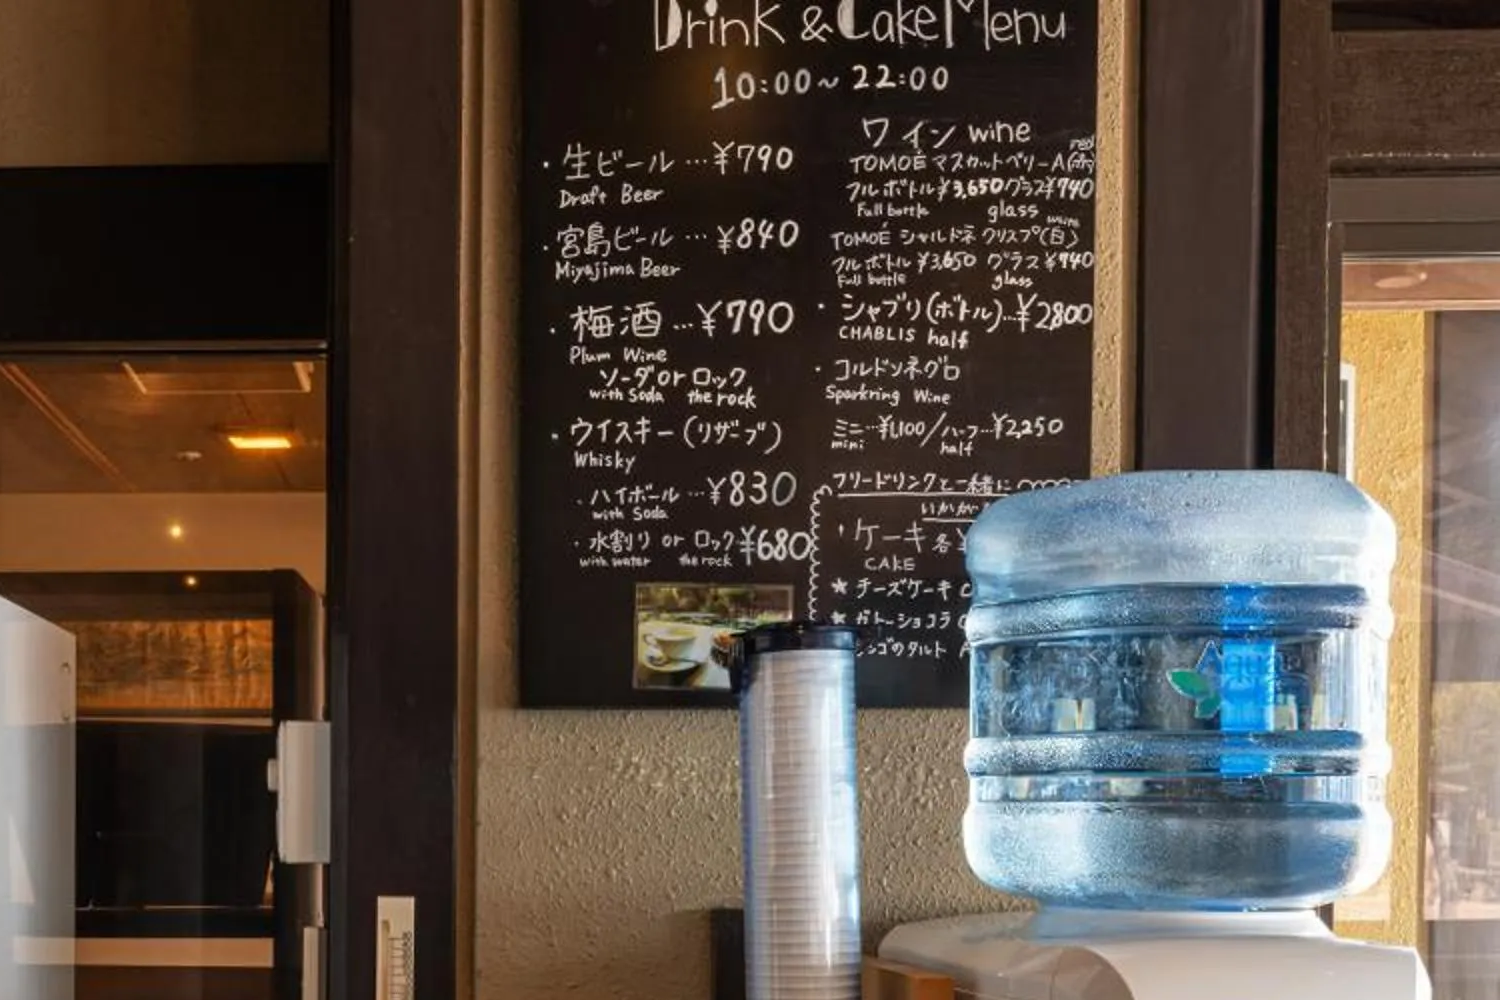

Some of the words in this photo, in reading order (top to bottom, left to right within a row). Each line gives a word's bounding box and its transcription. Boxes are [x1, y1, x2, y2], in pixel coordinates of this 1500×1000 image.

[655, 0, 786, 51] Drink
[801, 5, 833, 43] &
[837, 0, 939, 45] Cake
[945, 0, 1066, 51] Menu
[712, 66, 811, 110] 10:00
[852, 64, 949, 91] 22:00
[862, 117, 956, 148] ワイン
[968, 120, 1031, 143] wine
[563, 142, 675, 180] 生ビール
[712, 141, 794, 176] ¥790
[558, 185, 608, 209] Draft
[620, 182, 665, 205] Beer
[988, 202, 1039, 223] glass
[556, 221, 675, 259] 宮島ビール
[717, 217, 800, 255] ¥840
[555, 259, 635, 284] Miyajima
[639, 256, 681, 279] Beer
[991, 271, 1034, 290] glass
[568, 301, 662, 343] 梅酒
[696, 299, 795, 338] ¥790
[838, 325, 917, 343] CHABLIS
[927, 329, 970, 350] half
[569, 345, 612, 365] Plum
[623, 347, 668, 363] Wine
[599, 364, 655, 389] ソーダ
[657, 370, 687, 387] or
[692, 367, 747, 388] ロック
[588, 387, 624, 402] with
[687, 388, 713, 405] the
[716, 385, 758, 409] rock
[913, 388, 952, 405] Wine
[940, 441, 974, 457] half
[573, 451, 637, 475] Whisky
[590, 483, 680, 507] ハイボール
[707, 470, 798, 507] ¥830
[592, 508, 626, 521] with
[633, 505, 670, 522] Soda
[588, 528, 651, 553] 水割り
[661, 533, 686, 549] or
[694, 529, 735, 551] ロック
[739, 525, 813, 566] ¥680
[854, 517, 928, 553] ケーキ
[578, 556, 610, 568] with
[678, 554, 700, 567] the
[701, 554, 734, 568] rock
[864, 554, 917, 572] CAKE
